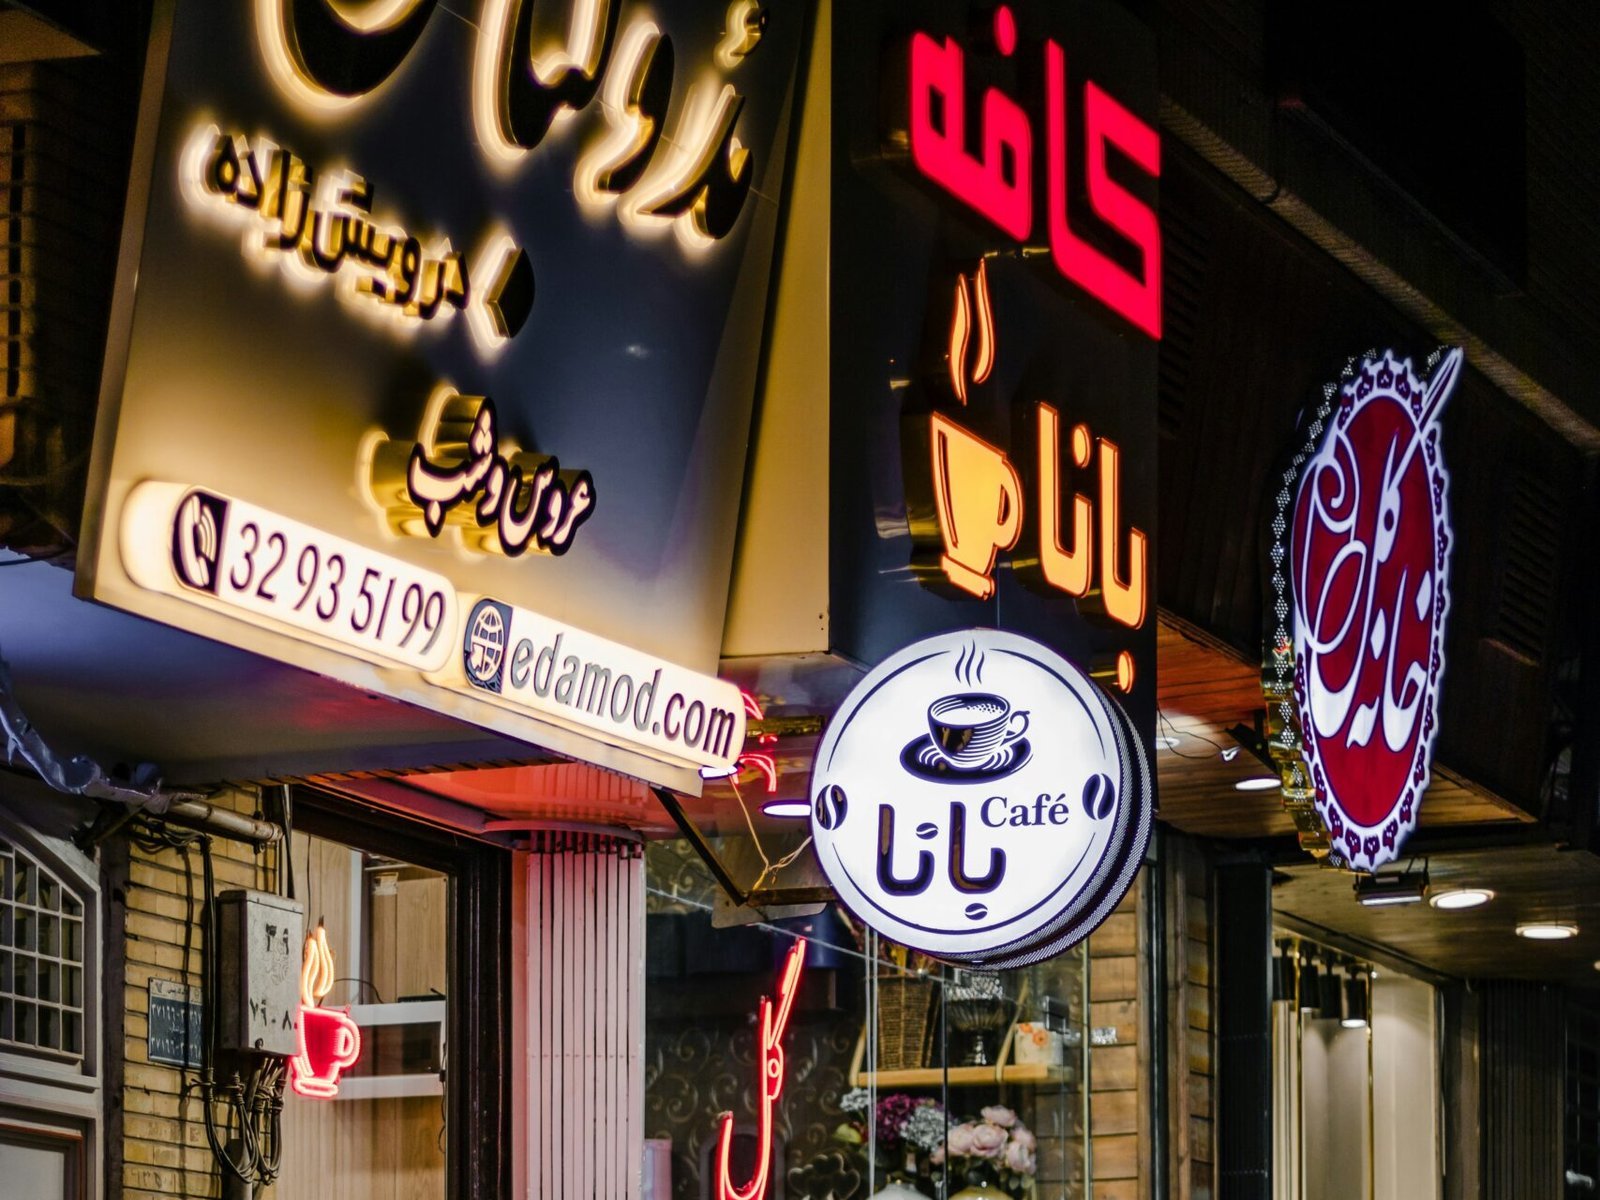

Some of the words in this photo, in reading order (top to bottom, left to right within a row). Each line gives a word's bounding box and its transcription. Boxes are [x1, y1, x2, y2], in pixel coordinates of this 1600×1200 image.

[909, 5, 1162, 341] کافه
[230, 520, 288, 602] 32
[293, 544, 347, 622] 93
[509, 632, 736, 760] edamod.com
[979, 791, 1069, 828] Café
